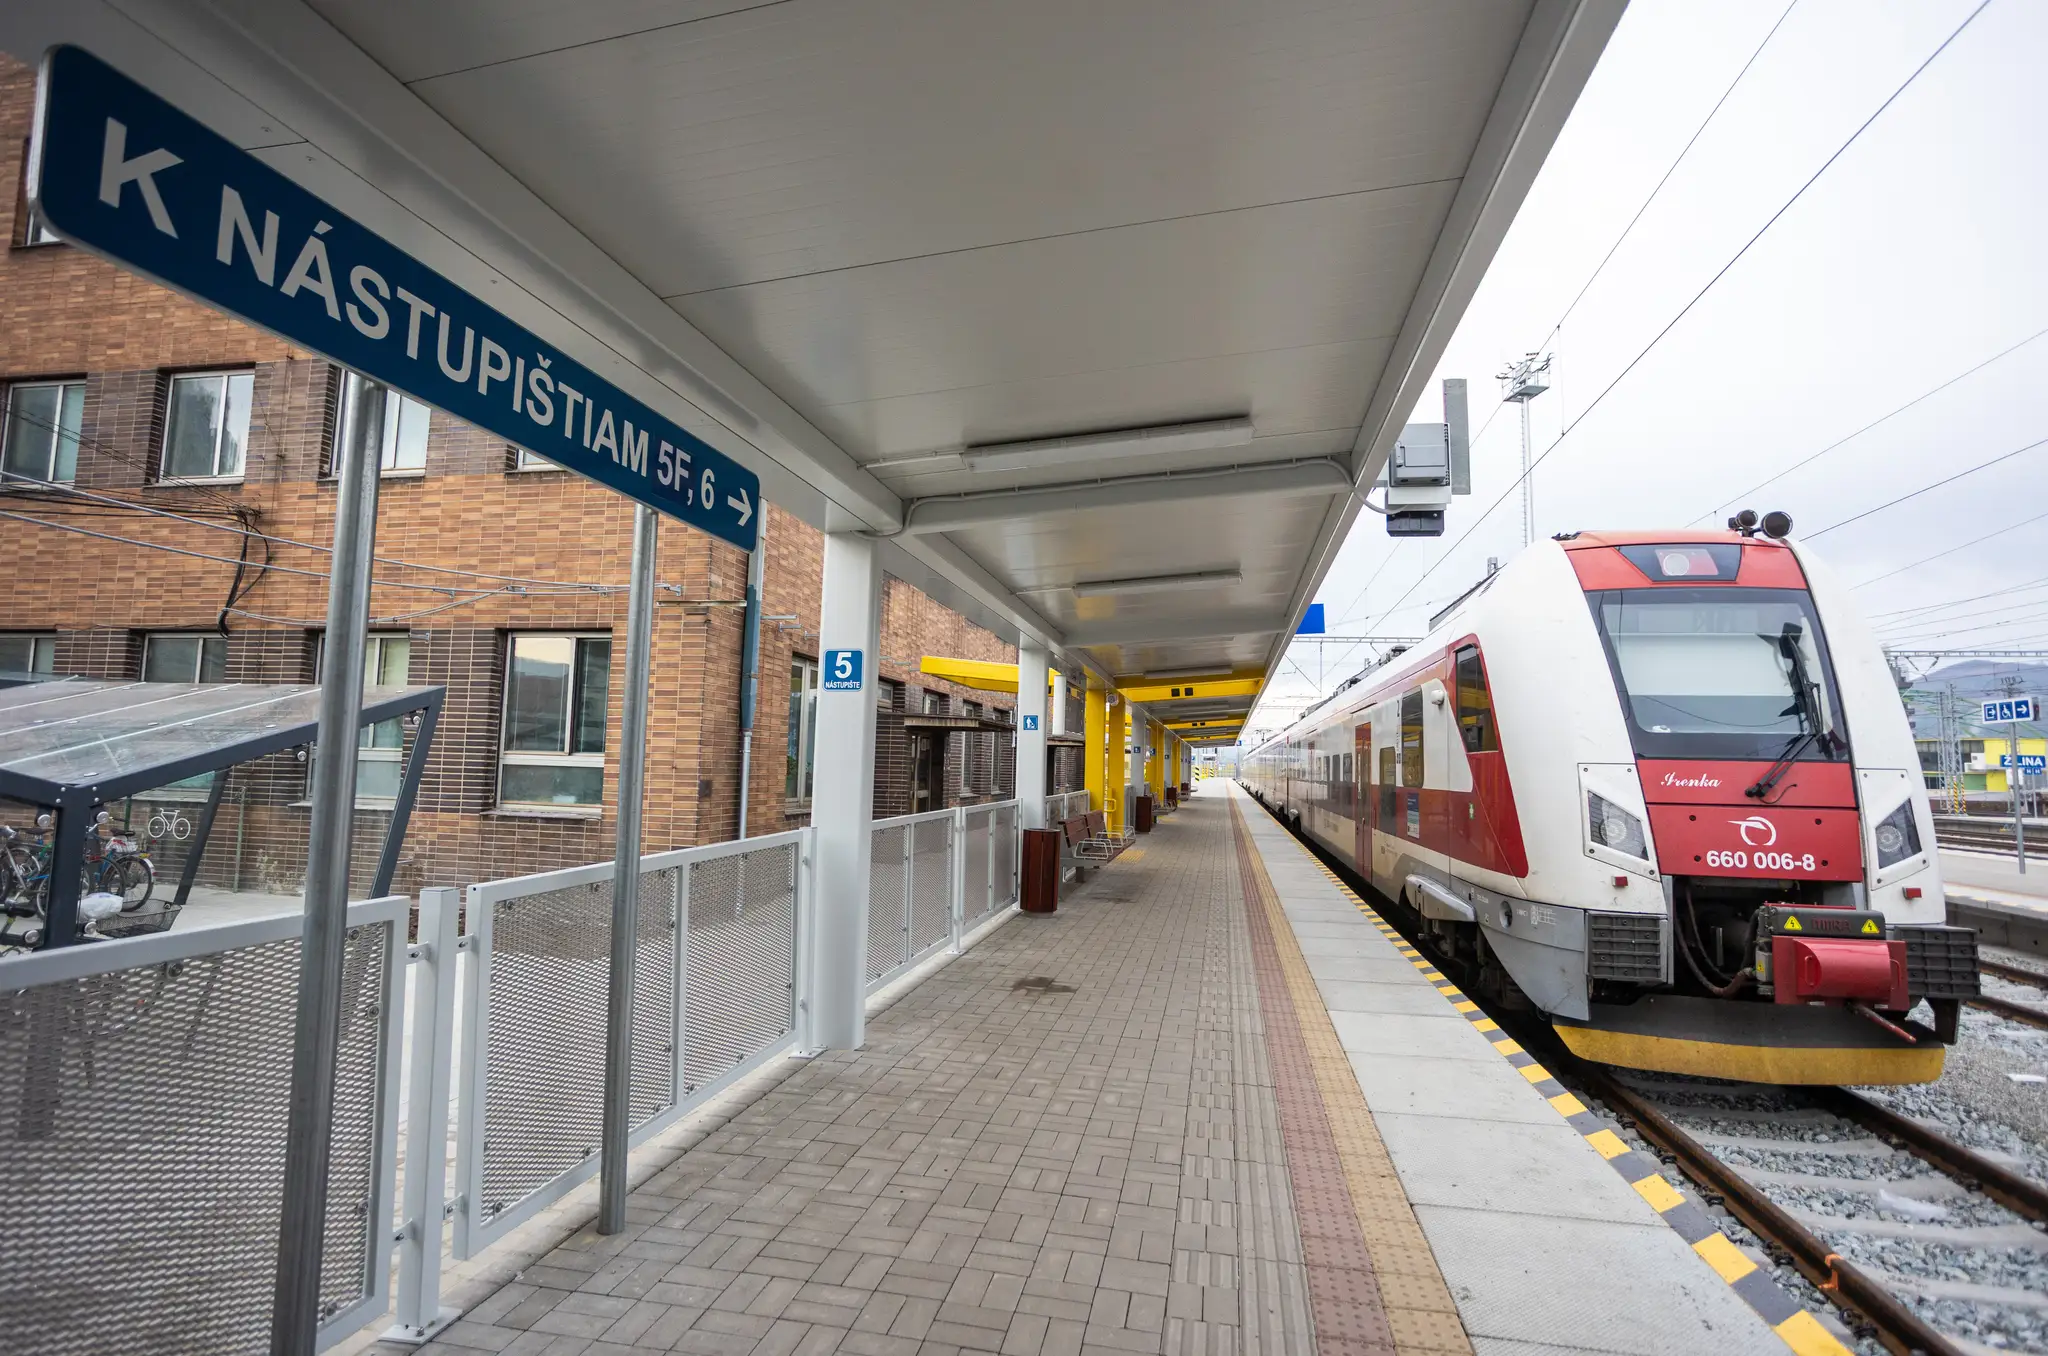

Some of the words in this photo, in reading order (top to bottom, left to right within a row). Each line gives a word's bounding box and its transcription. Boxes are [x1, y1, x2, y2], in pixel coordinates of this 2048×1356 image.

[99, 116, 184, 240] K
[216, 184, 649, 478] NÁSTUPIŠTIAM
[657, 440, 694, 506] 5F,
[701, 468, 716, 510] 6
[834, 651, 853, 679] 5
[825, 679, 861, 689] NÁSTUPIŠTE
[2003, 754, 2044, 767] ŽINA
[1660, 771, 1723, 788] Irenka
[1706, 850, 1748, 869] 660
[1753, 851, 1816, 872] 006-8
